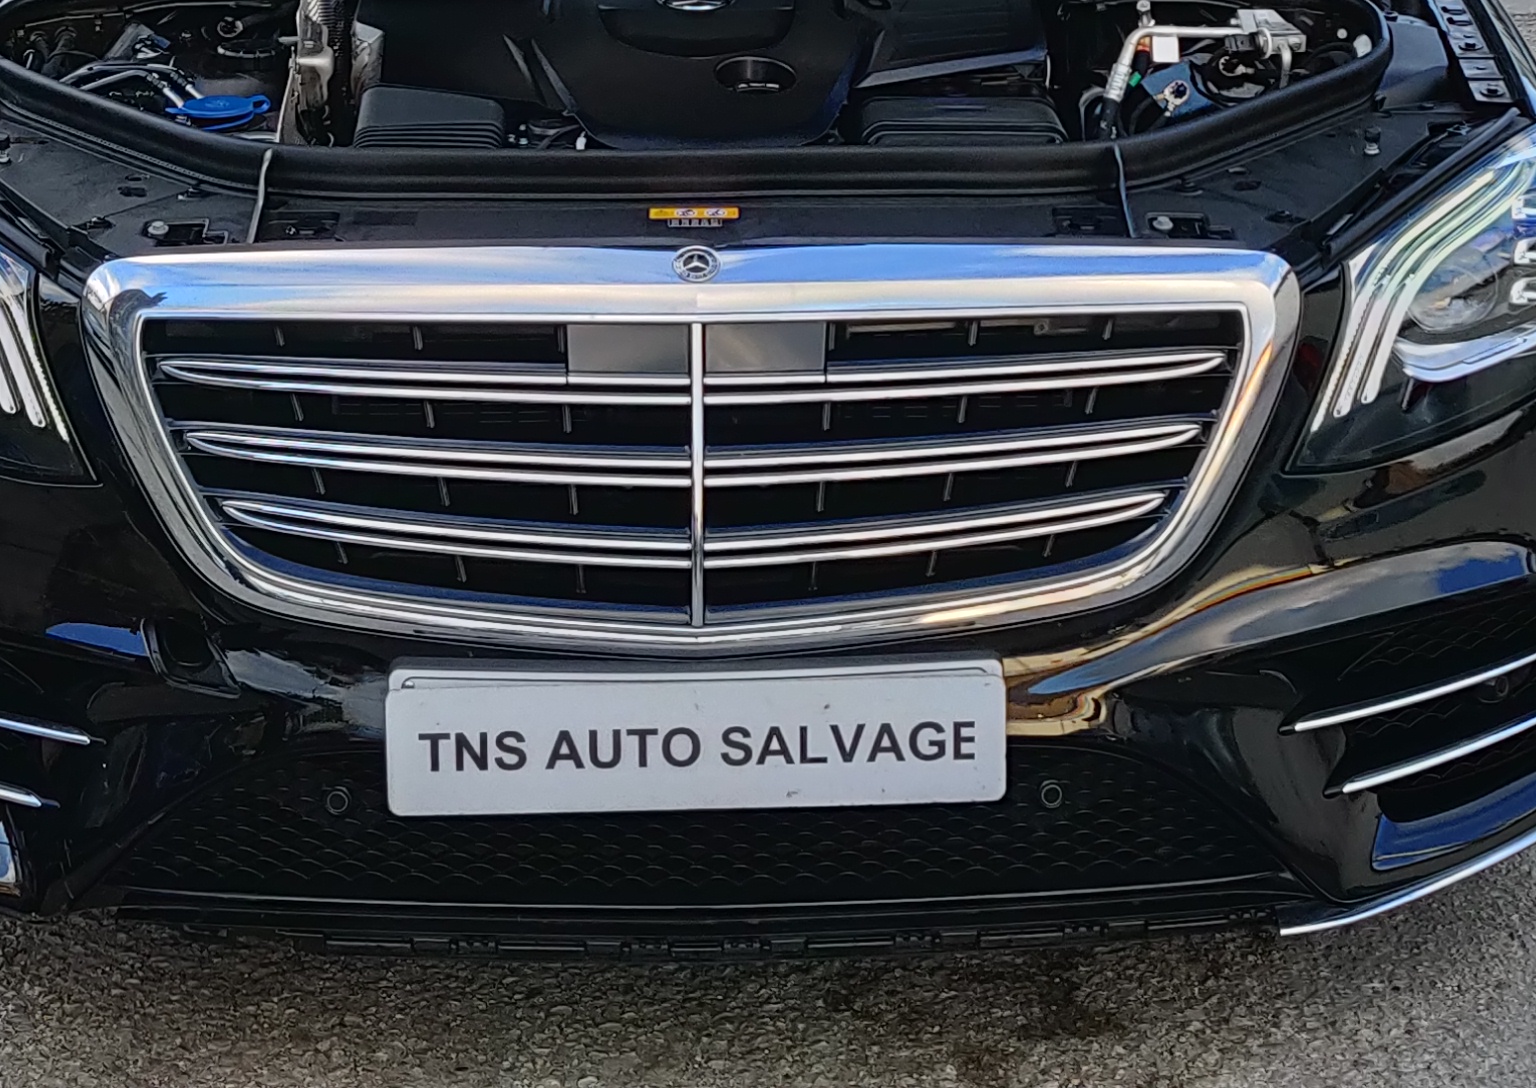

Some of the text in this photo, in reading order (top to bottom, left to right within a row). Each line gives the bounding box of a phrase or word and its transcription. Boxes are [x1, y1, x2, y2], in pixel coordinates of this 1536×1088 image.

[418, 720, 976, 772] TNS AUTO SALVAGE
